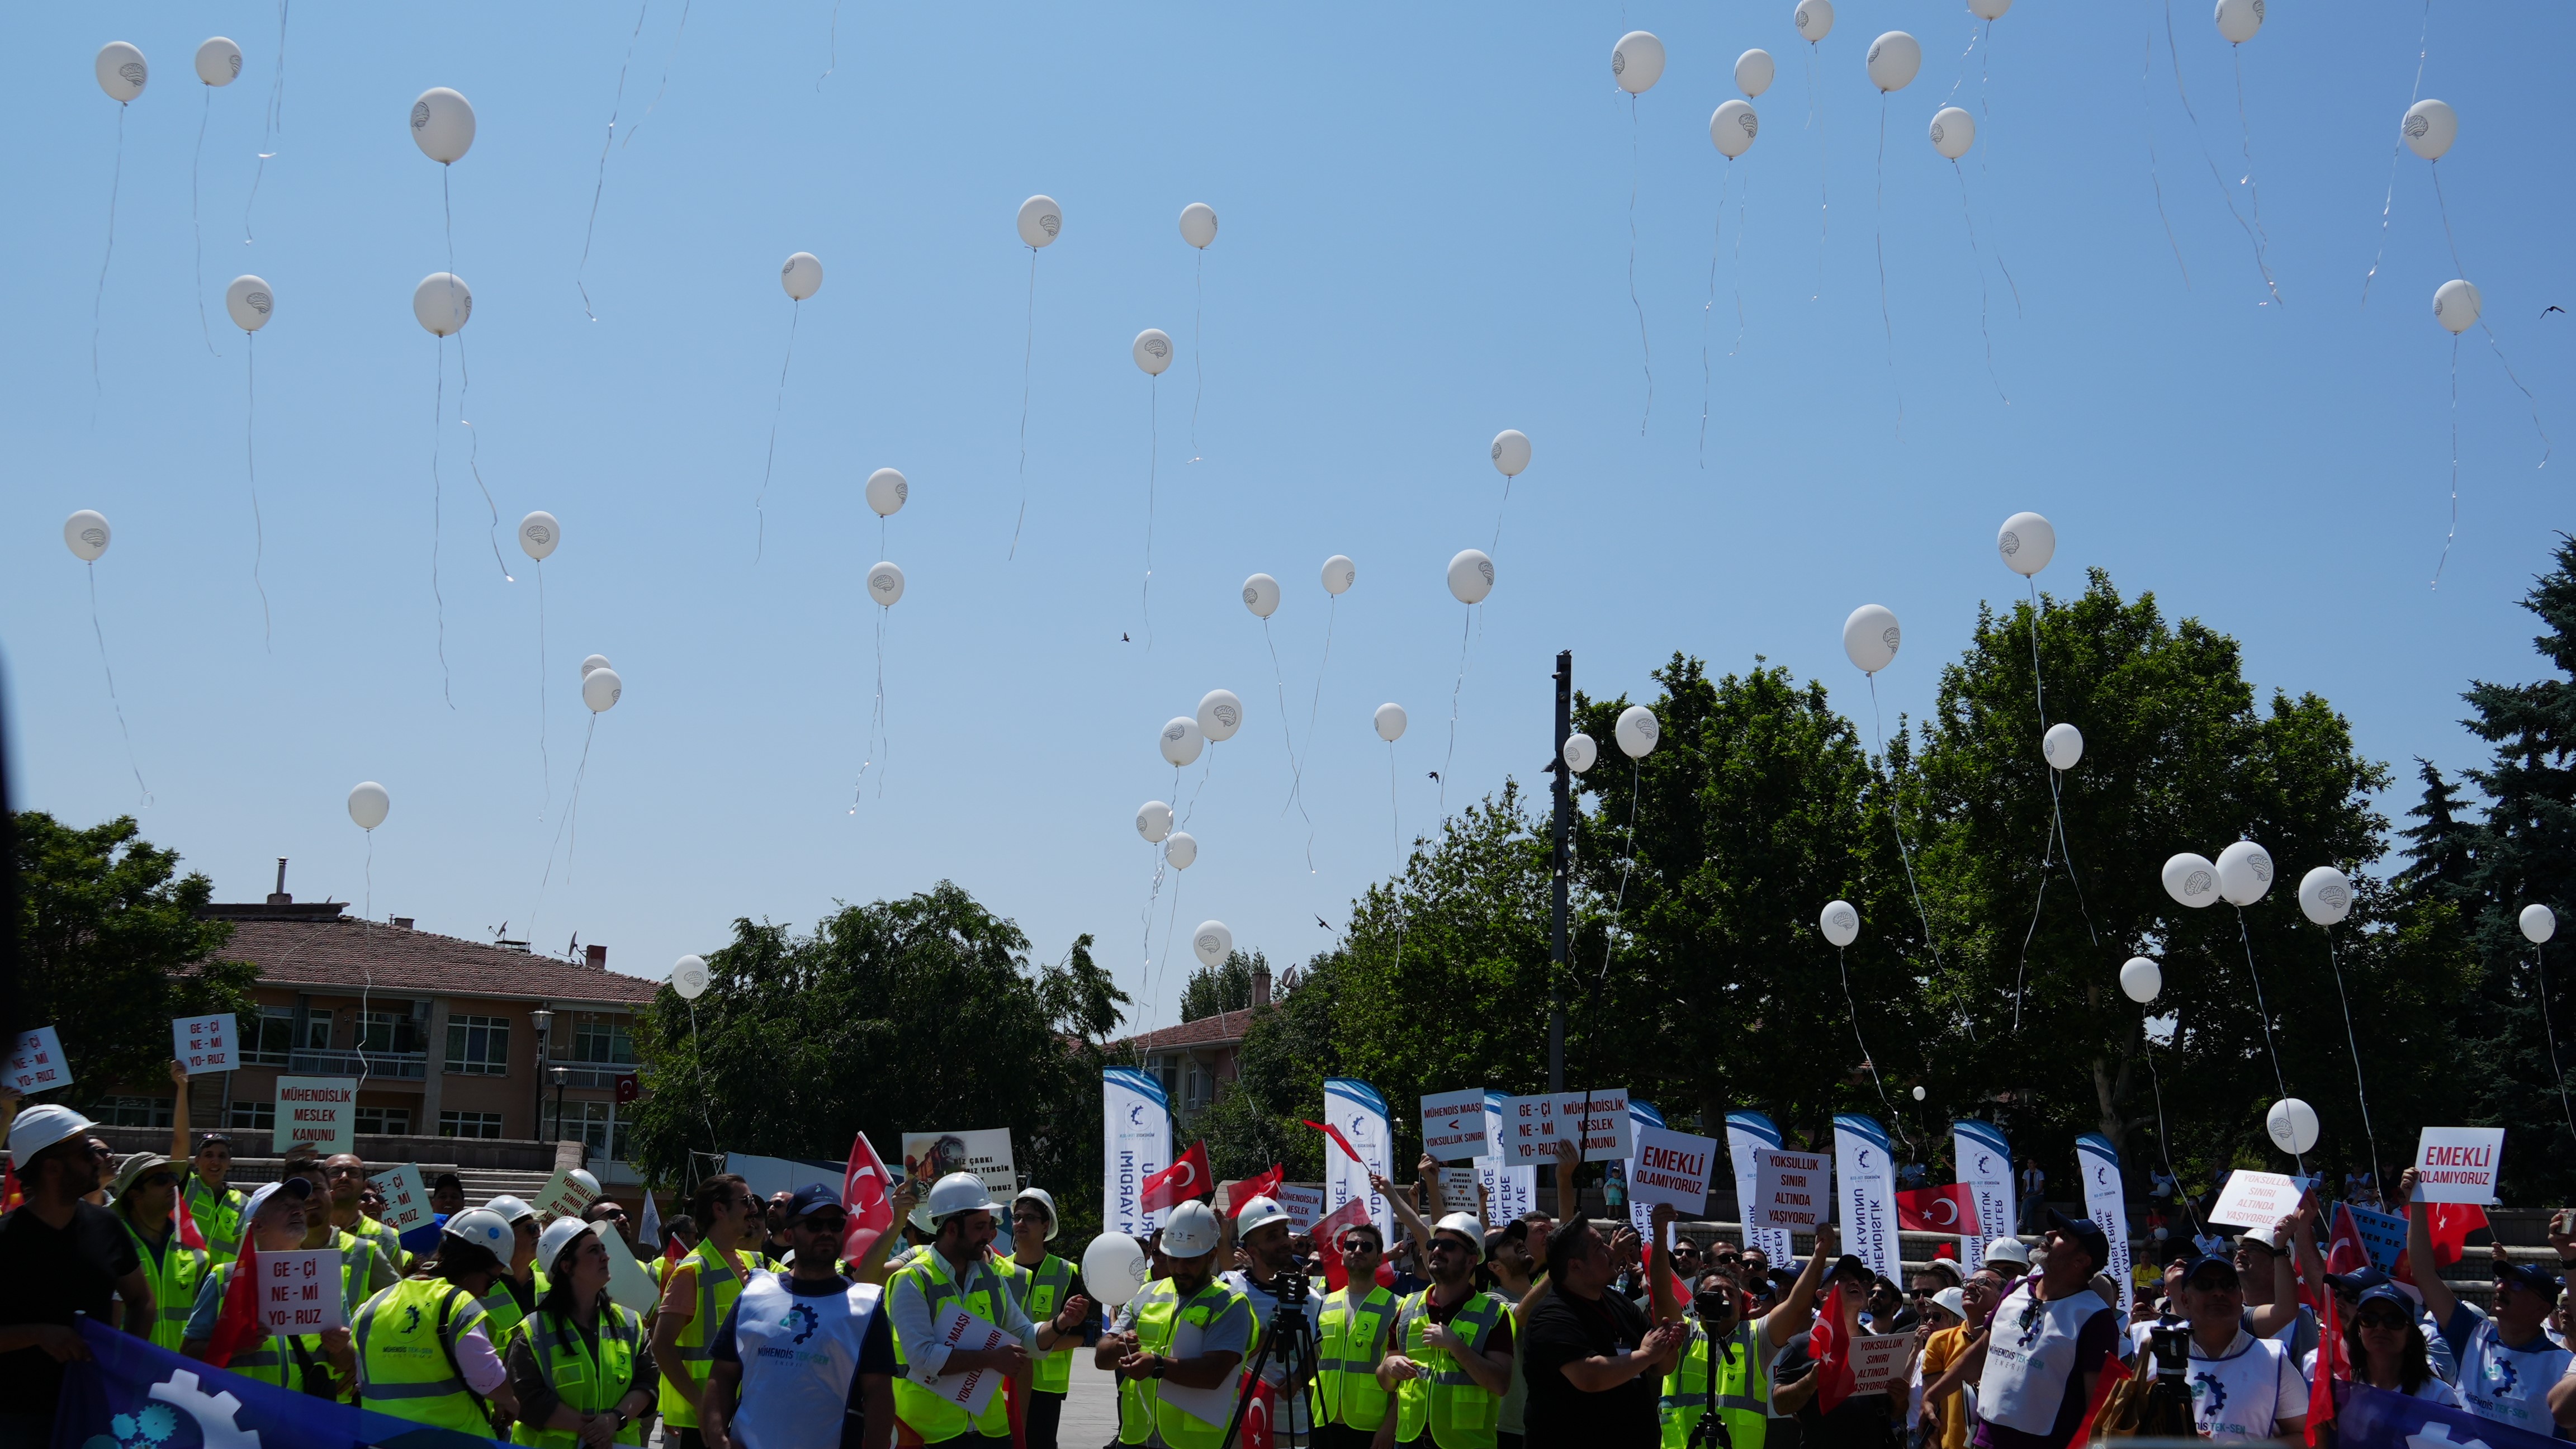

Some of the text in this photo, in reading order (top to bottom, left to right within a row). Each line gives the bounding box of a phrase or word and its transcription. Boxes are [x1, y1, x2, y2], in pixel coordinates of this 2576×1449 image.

[191, 1023, 202, 1034] GE
[210, 1020, 219, 1034] Çİ
[29, 1034, 41, 1050] Çİ
[191, 1039, 202, 1050] NE
[211, 1037, 222, 1049] Mİ
[35, 1050, 49, 1064] Mİ
[207, 1053, 225, 1064] RUZ
[36, 1069, 57, 1083] RUZ
[281, 1086, 352, 1102] MÜHENDİSLİK
[294, 1109, 335, 1122] MESLEK
[1424, 1102, 1482, 1119] MÜHENDİS MAAŞI
[1519, 1104, 1531, 1117] GE
[1541, 1100, 1551, 1117] Çİ
[292, 1128, 335, 1142] KANUNU
[1519, 1124, 1532, 1137] NE
[1542, 1120, 1554, 1135] Mİ
[1426, 1131, 1484, 1148] YOKSULLUK SINIRI
[1538, 1142, 1557, 1156] RUZ
[2425, 1144, 2491, 1167] EMEKLİ
[954, 1155, 966, 1165] BİZ
[1642, 1145, 1704, 1176] EMEKLİ
[1769, 1155, 1819, 1171] YOKSULLUK
[393, 1173, 404, 1190] Çİ
[1636, 1169, 1702, 1195] OLAMIYORUZ
[1781, 1174, 1806, 1188] SINIRI
[2244, 1175, 2295, 1187] YOKSULLUK
[2419, 1170, 2490, 1185] OLAMIYORUZ
[562, 1176, 597, 1202] YOKSULLU
[2248, 1187, 2276, 1197] SINIRI
[398, 1190, 412, 1206] Mİ
[562, 1192, 584, 1210] SINIRI
[1278, 1191, 1319, 1205] MÜHENDİSLİK
[1774, 1192, 1810, 1206] ALTINDA
[2236, 1199, 2275, 1211] ALTINDA
[399, 1208, 420, 1226] RUZ
[1769, 1210, 1815, 1225] YAŞIYORUZ
[2225, 1210, 2275, 1224] YAŞIYORUZ
[274, 1262, 290, 1277] GE
[304, 1258, 316, 1278] Çİ
[272, 1286, 289, 1301] NE
[302, 1282, 318, 1300] Mİ
[296, 1309, 321, 1324] RUZ
[948, 1313, 970, 1342] MAAŞI
[1860, 1338, 1904, 1351] YOKSULLUK
[757, 1345, 830, 1366] MÜHENDİS TEK-SEN
[1866, 1354, 1890, 1364] SINIRI
[1989, 1344, 2044, 1369] MÜHENDİS TEK-SEN
[1857, 1367, 1889, 1379] ALTINDA
[2494, 1404, 2528, 1419] TEK-SEN
[2211, 1422, 2246, 1435] TEK-SEN
